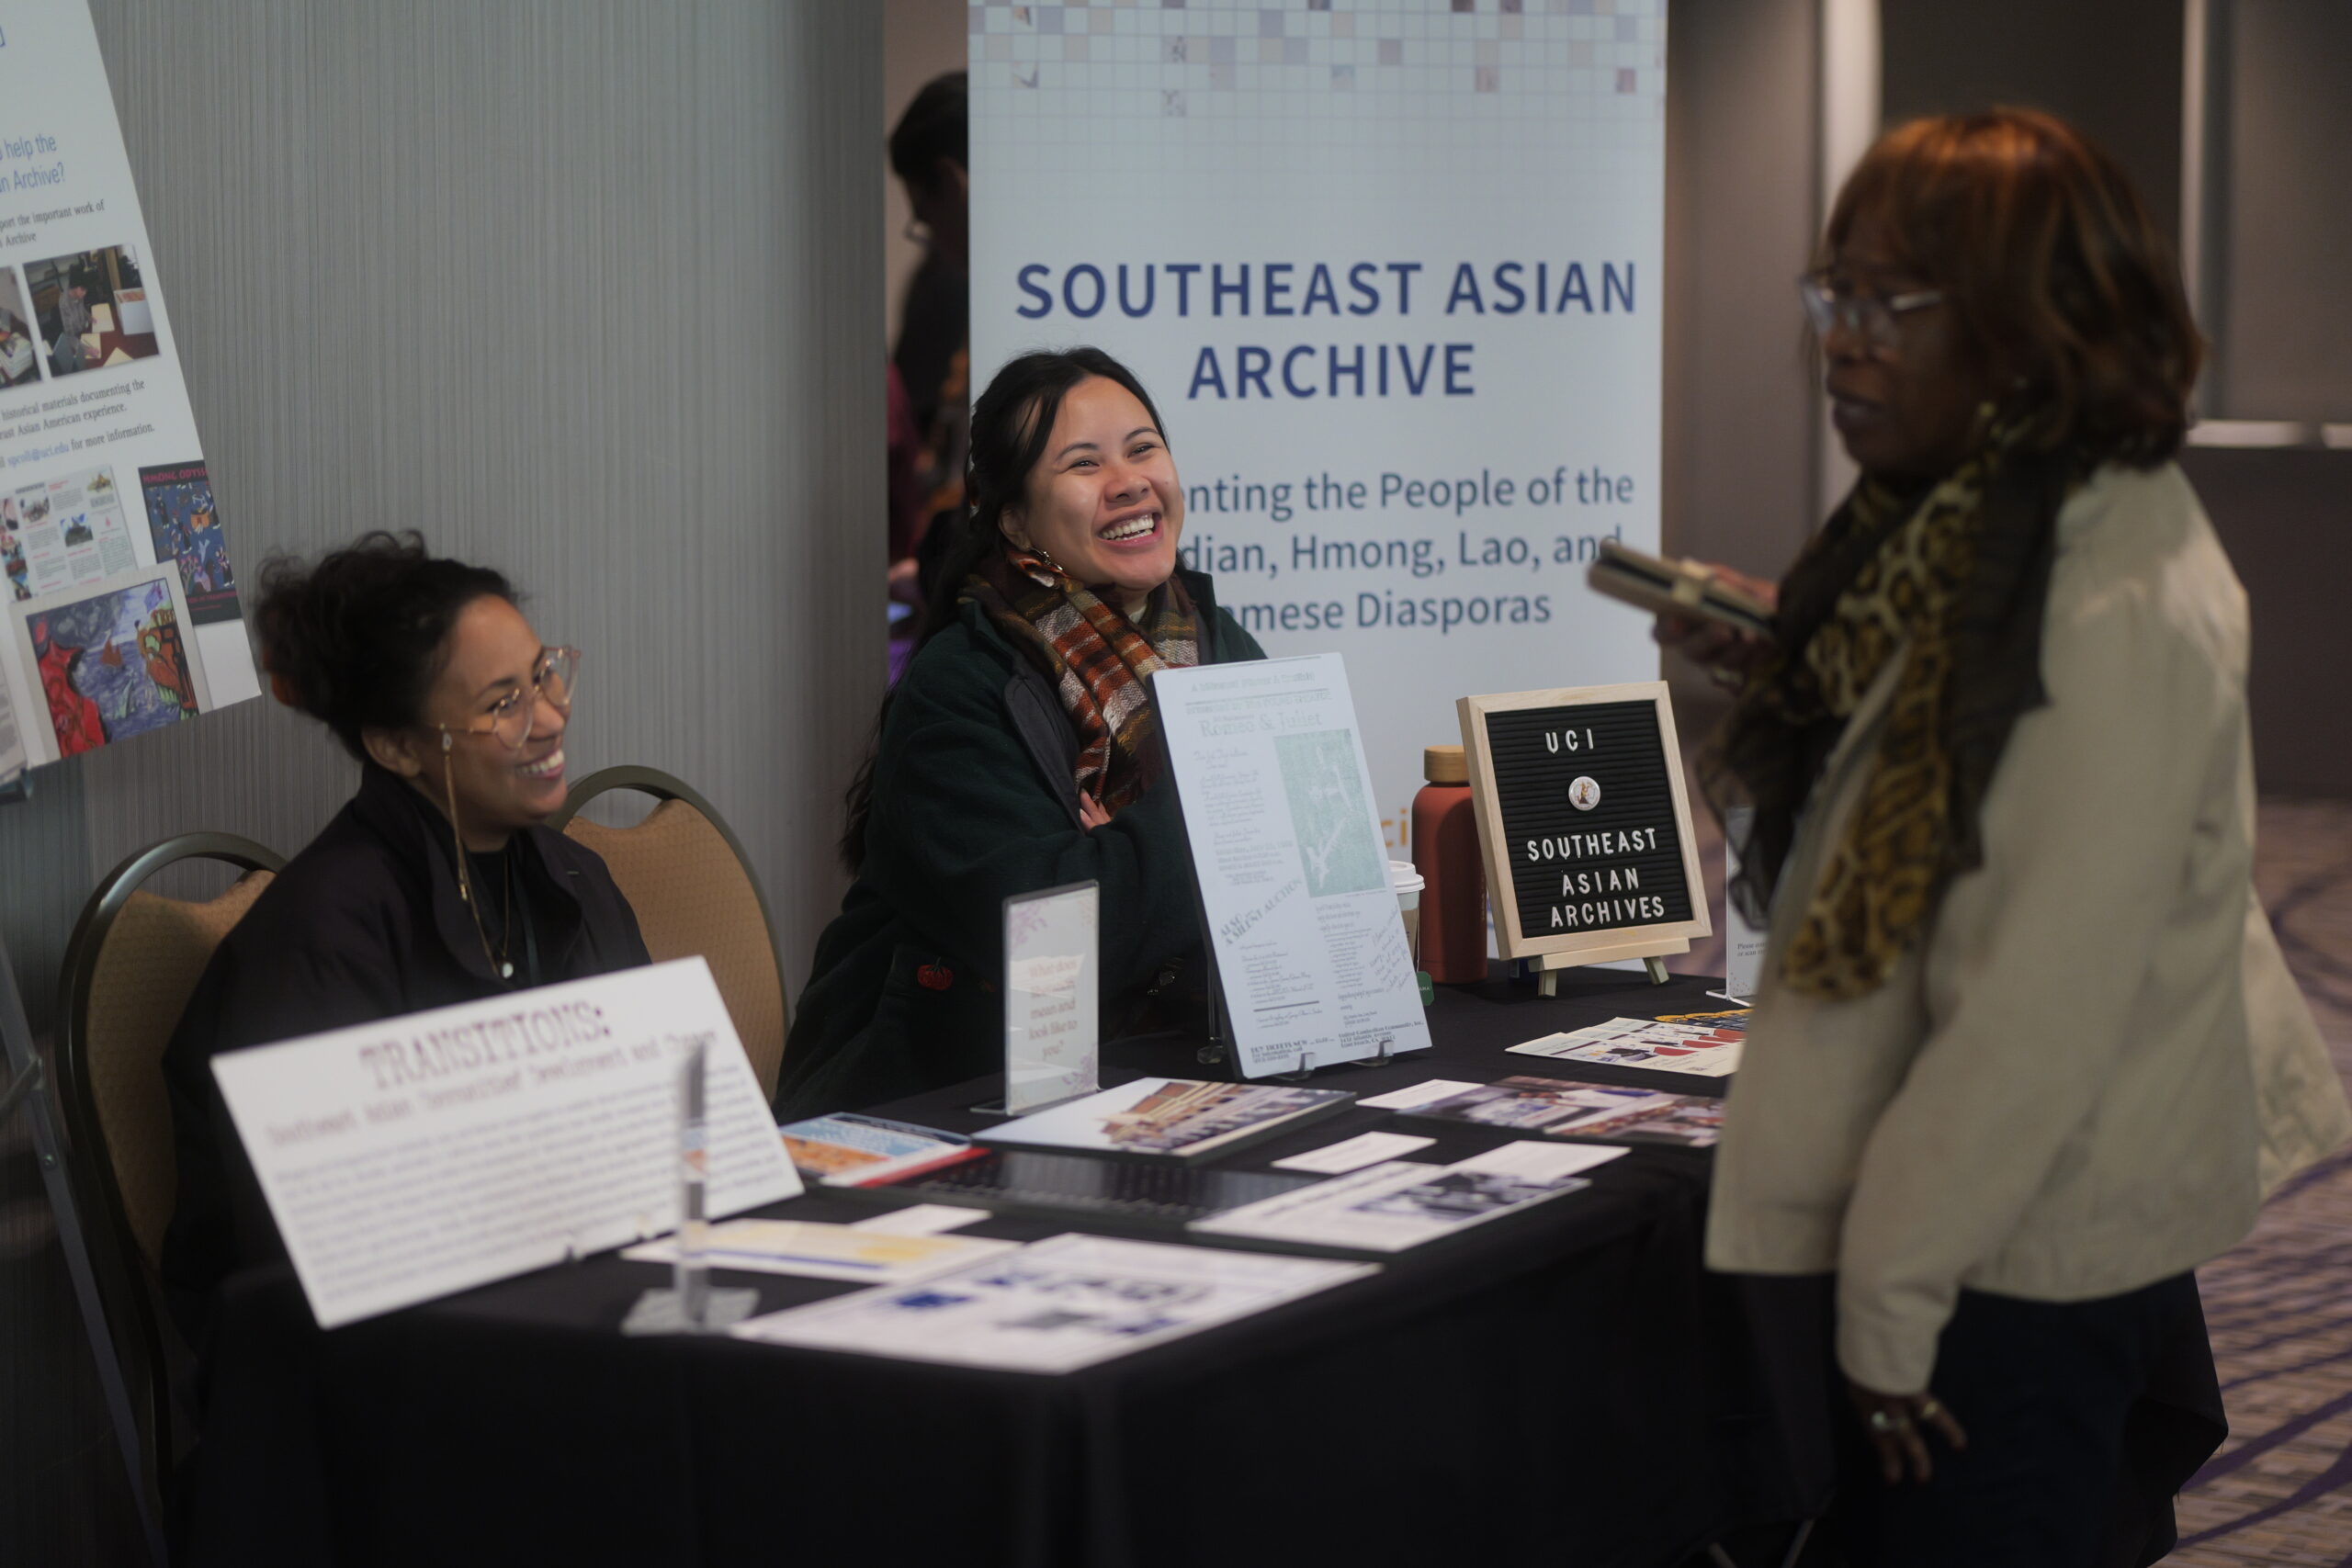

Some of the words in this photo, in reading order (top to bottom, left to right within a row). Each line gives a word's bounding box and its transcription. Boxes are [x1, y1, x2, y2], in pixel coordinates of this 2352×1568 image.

[4, 136, 33, 161] help
[35, 133, 57, 153] the
[14, 162, 65, 190] Archive?
[17, 214, 29, 226] the
[33, 207, 73, 225] important
[74, 202, 95, 214] work
[96, 198, 105, 211] of
[6, 231, 37, 247] Archive
[1016, 262, 1422, 320] SOUTHEAST
[1445, 261, 1634, 315] ASIAN
[1188, 344, 1476, 400] ARCHIVE
[2, 401, 40, 421] historical
[42, 394, 79, 412] materials
[80, 381, 131, 404] documenting
[132, 378, 145, 391] the
[17, 423, 41, 436] Asian
[43, 412, 82, 430] American
[83, 403, 128, 422] experience.
[72, 439, 84, 451] for
[85, 434, 106, 447] more
[107, 422, 155, 442] information.
[1184, 474, 1293, 522] nting
[1306, 473, 1366, 510] the
[1382, 469, 1514, 515] People
[1528, 468, 1565, 504] of
[1577, 467, 1634, 503] the
[1294, 536, 1444, 578] Hmong,
[1461, 531, 1540, 568] Lao,
[1359, 593, 1550, 634] Diasporas
[1545, 728, 1594, 754] UCI
[1527, 828, 1657, 862] SOUTHEAST
[1562, 867, 1640, 897] ASIAN
[1551, 896, 1665, 929] ARCHIVES
[1058, 996, 1076, 1013] and
[358, 999, 613, 1090] TRANSITIONS:
